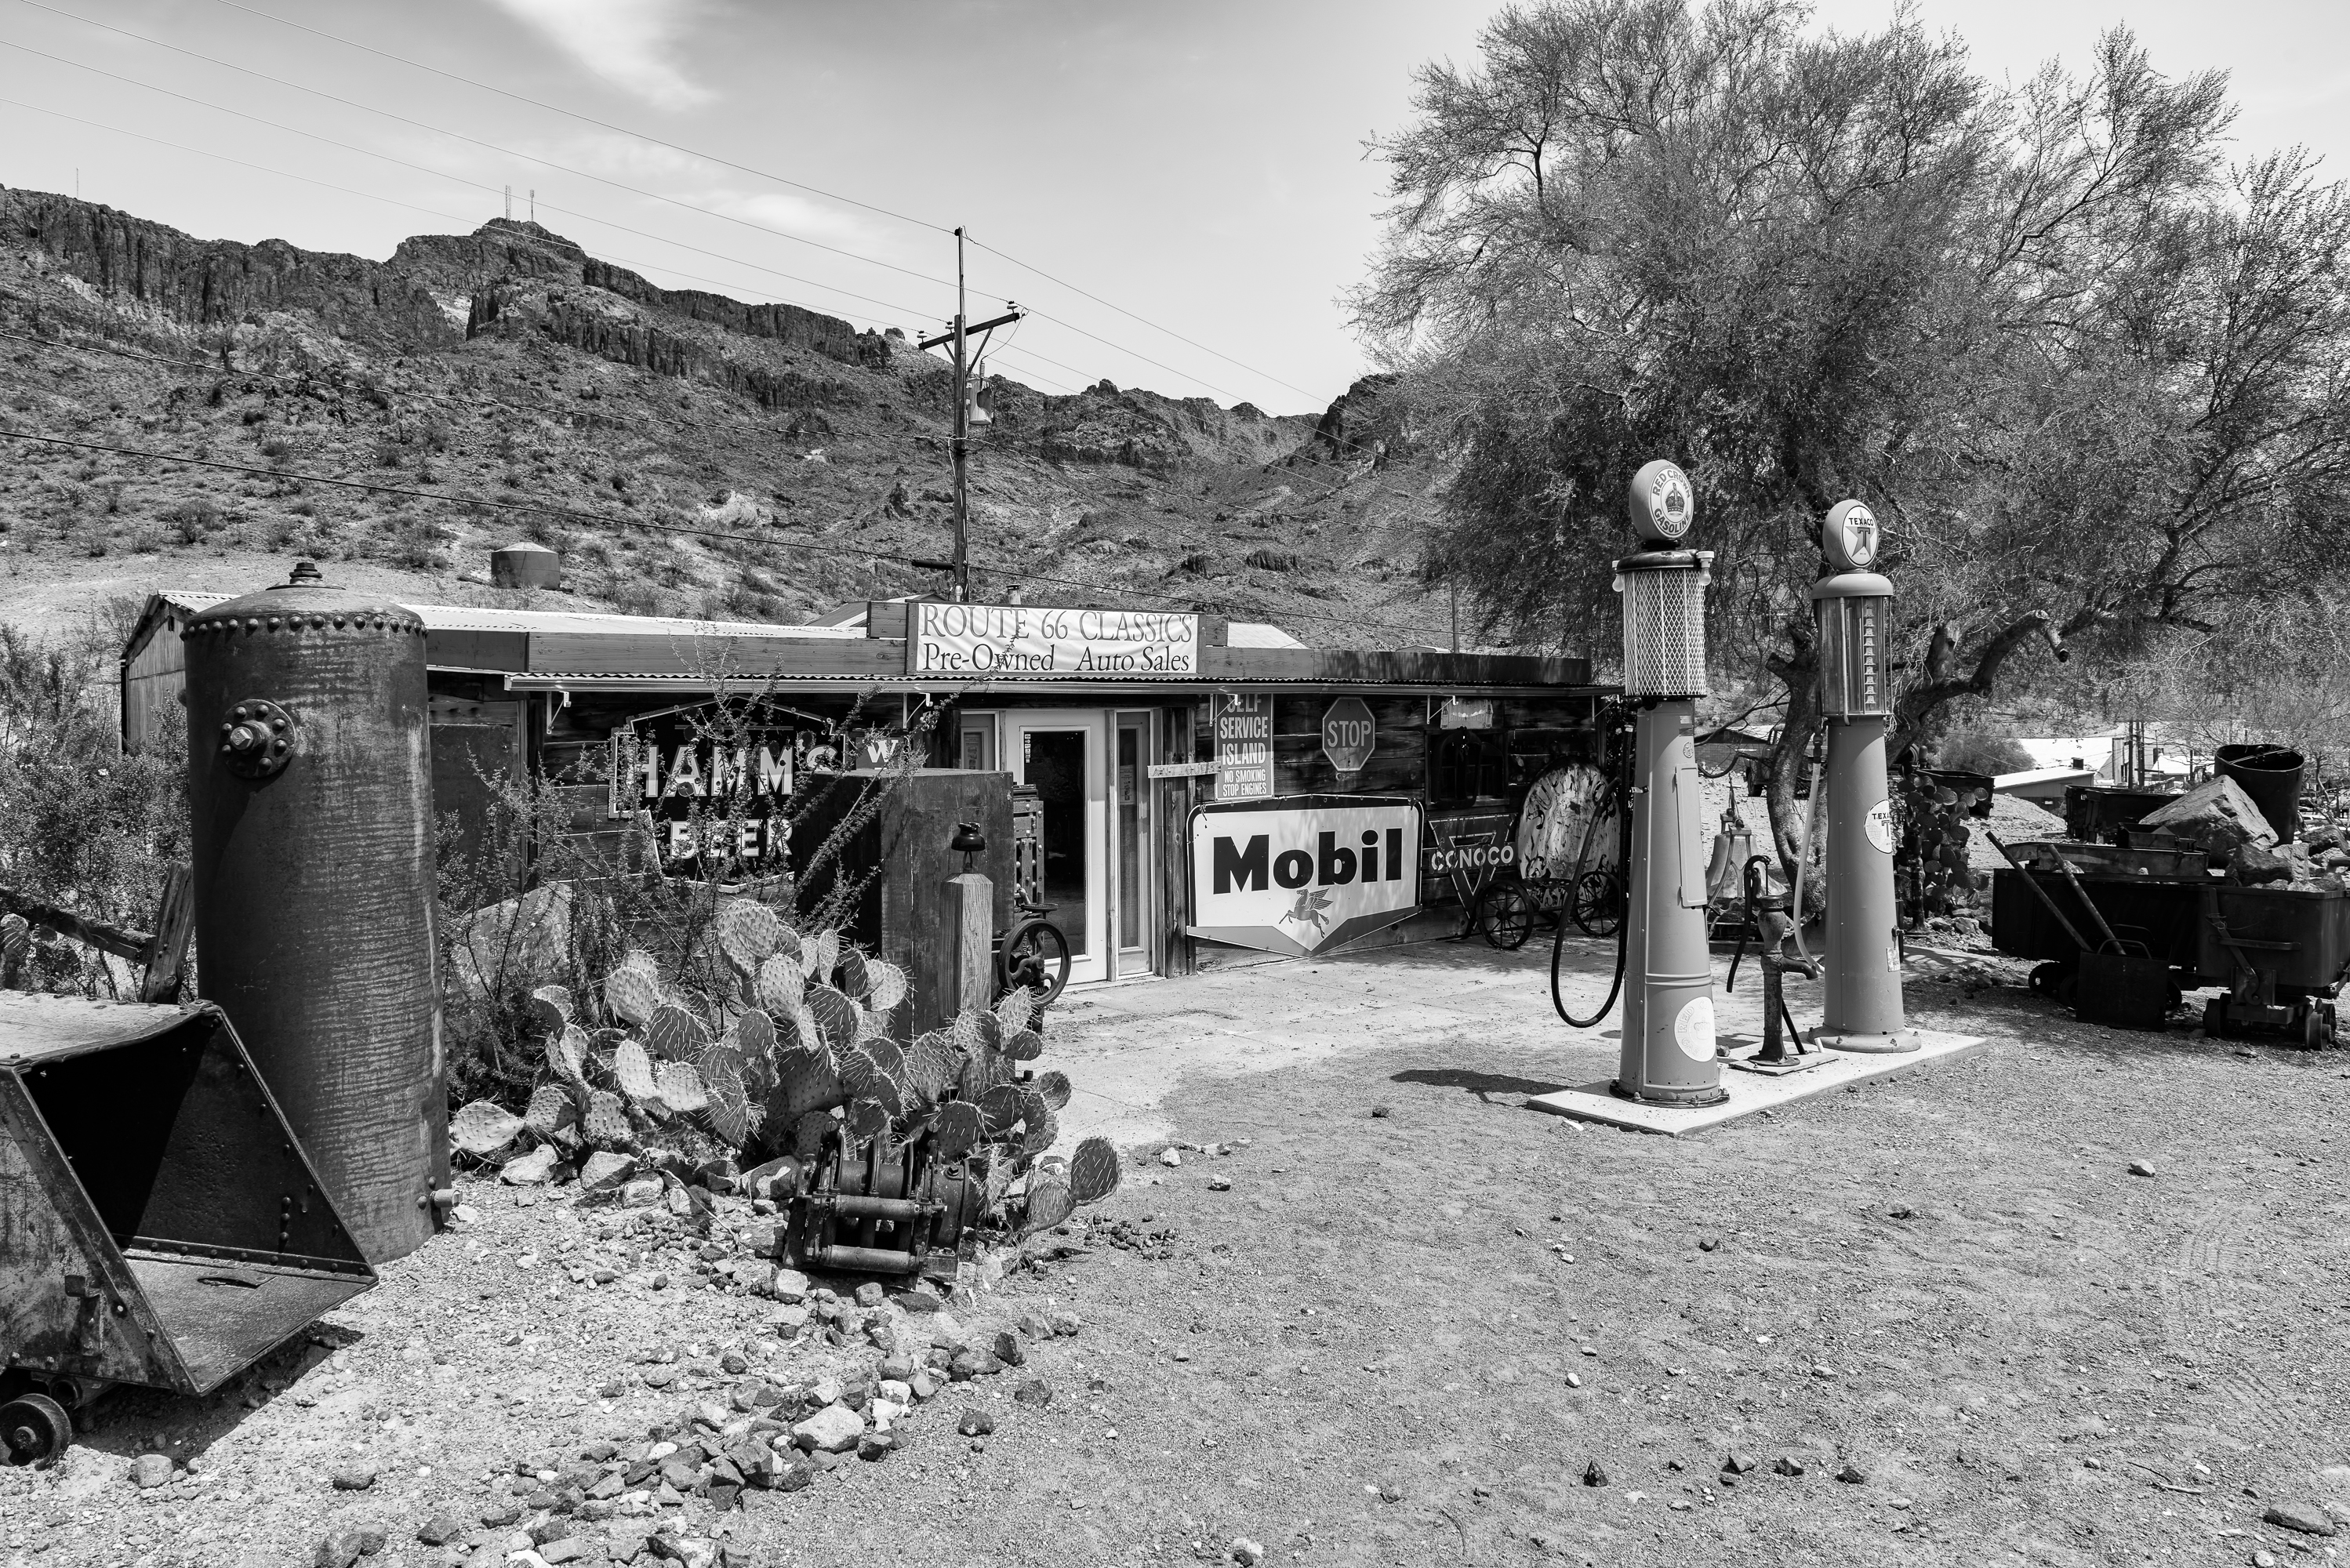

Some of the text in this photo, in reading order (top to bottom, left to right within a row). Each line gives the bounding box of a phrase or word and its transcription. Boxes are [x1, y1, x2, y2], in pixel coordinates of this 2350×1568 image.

[1652, 470, 1691, 499] RED CROWN
[1654, 508, 1691, 533] GASOLINE
[1848, 517, 1874, 526] TEXACO
[921, 604, 1192, 642] ROUTE 66 CLASSICS
[923, 643, 1190, 671] Pre-Owned Auto Sales
[1227, 694, 1262, 713] SELF
[1219, 716, 1269, 739] SERVICE
[1327, 720, 1371, 747] STOP
[1222, 742, 1266, 765] ISLAND
[1222, 782, 1267, 797] STOP ENGINES
[1224, 769, 1266, 783] NO SMOKING
[670, 818, 793, 859] BEER
[1213, 827, 1403, 895] Mobil
[1430, 845, 1514, 872] CONOCO
[1677, 1006, 1694, 1033] RED
